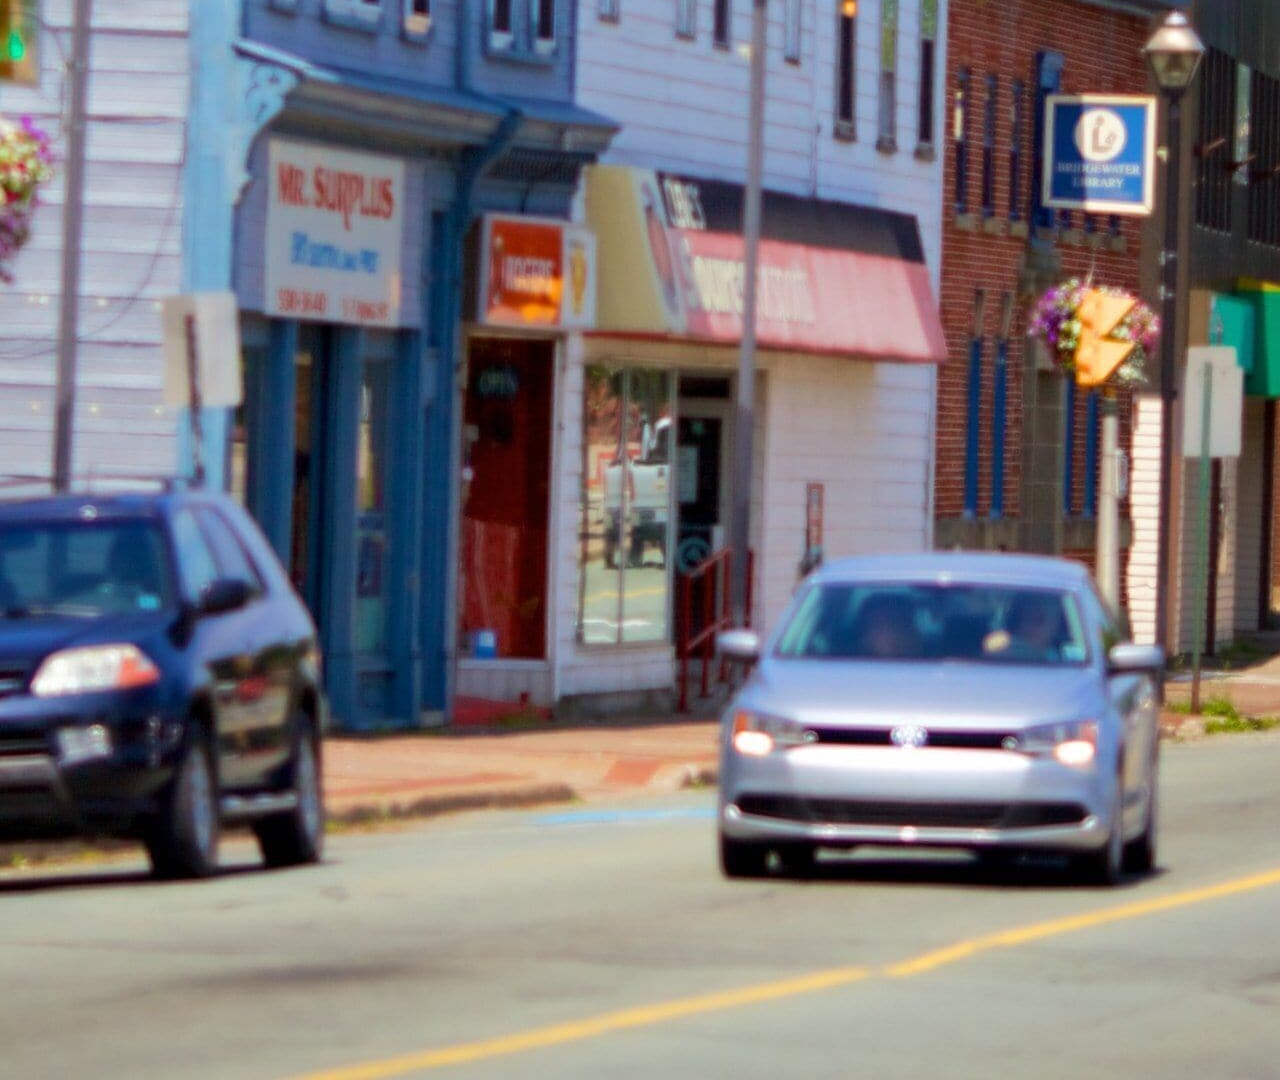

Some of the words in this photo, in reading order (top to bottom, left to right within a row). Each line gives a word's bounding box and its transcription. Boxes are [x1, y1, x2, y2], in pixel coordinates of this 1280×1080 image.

[1057, 162, 1141, 177] BRIDGEWATER
[1072, 175, 1125, 189] LIBRARY
[313, 166, 394, 231] SURPLUS
